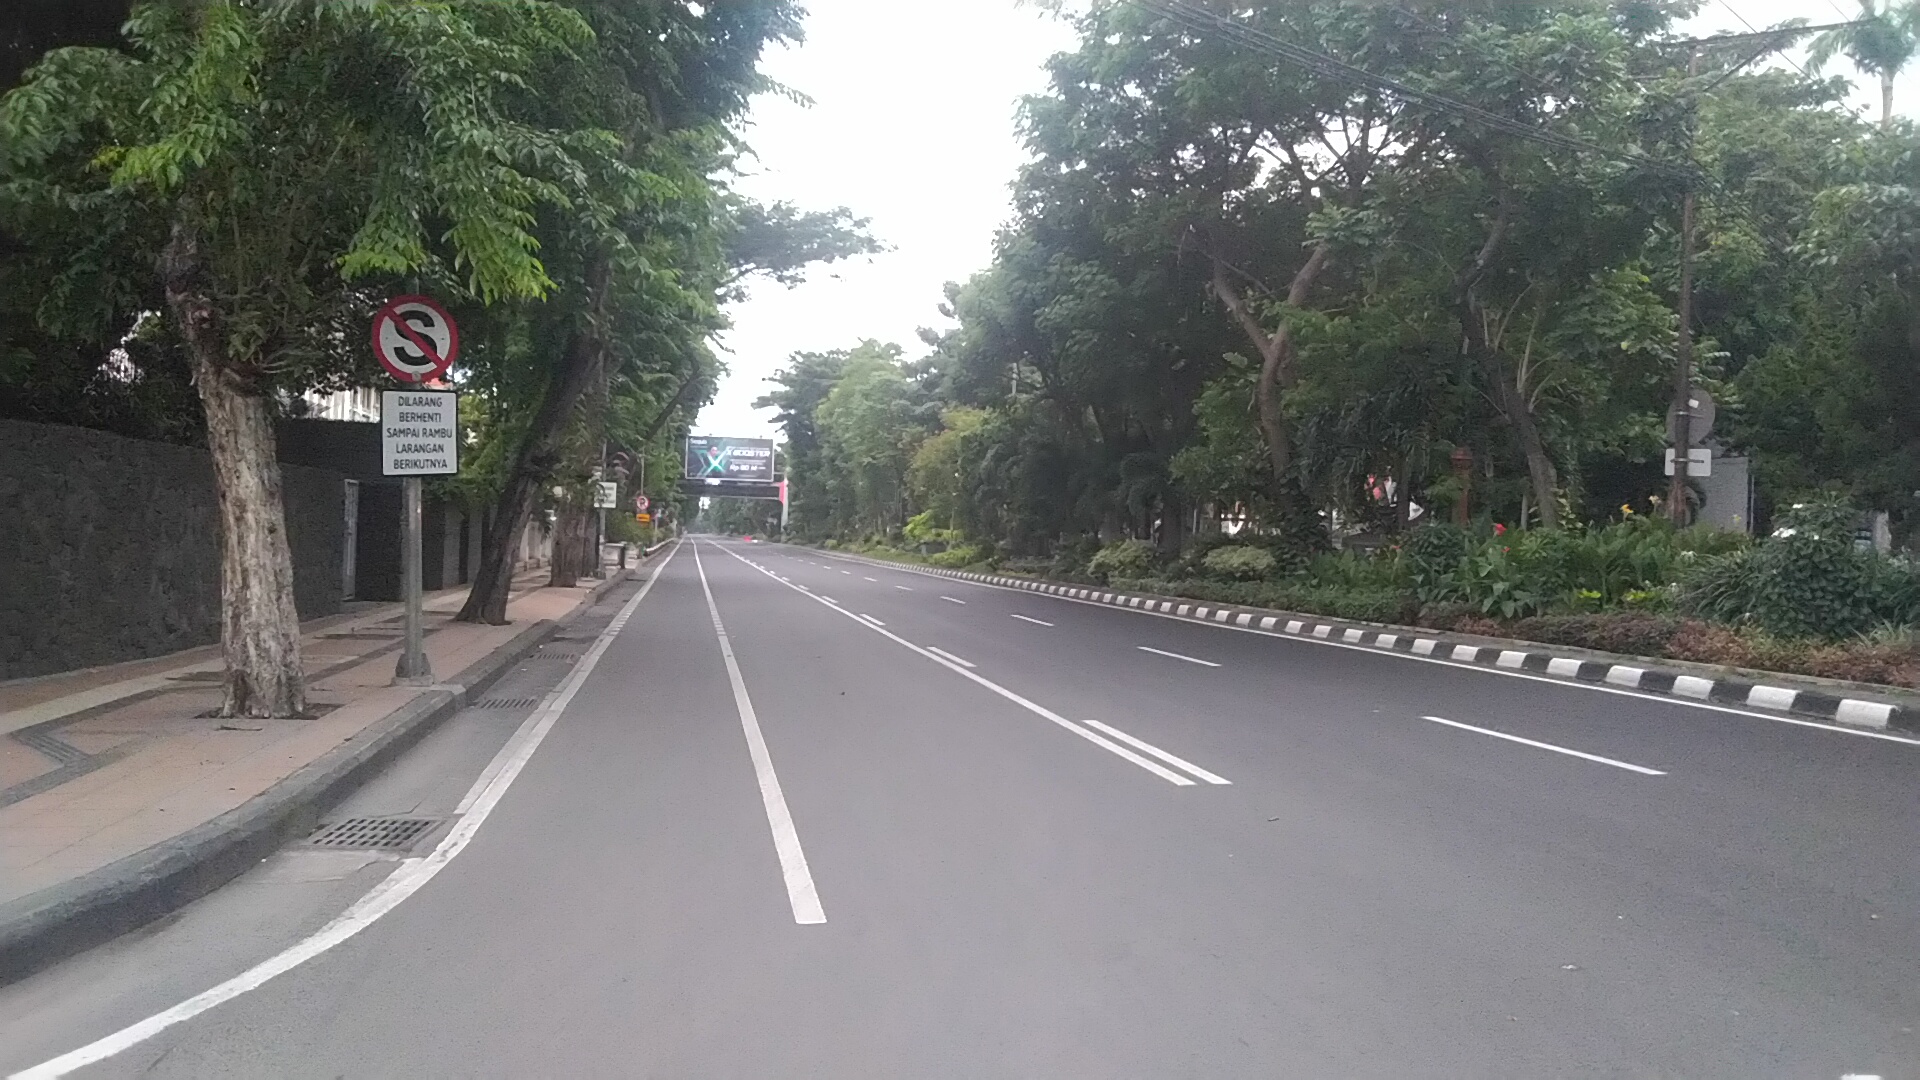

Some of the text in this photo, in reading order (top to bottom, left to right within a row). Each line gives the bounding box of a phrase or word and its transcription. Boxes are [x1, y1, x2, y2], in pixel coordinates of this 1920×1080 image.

[398, 396, 443, 408] DILARANG
[399, 411, 442, 423] BERHENTI
[386, 427, 453, 439] SAMPAI RAMBU
[395, 442, 445, 454] LARANGAN
[393, 458, 448, 470] BERIKUTNYA
